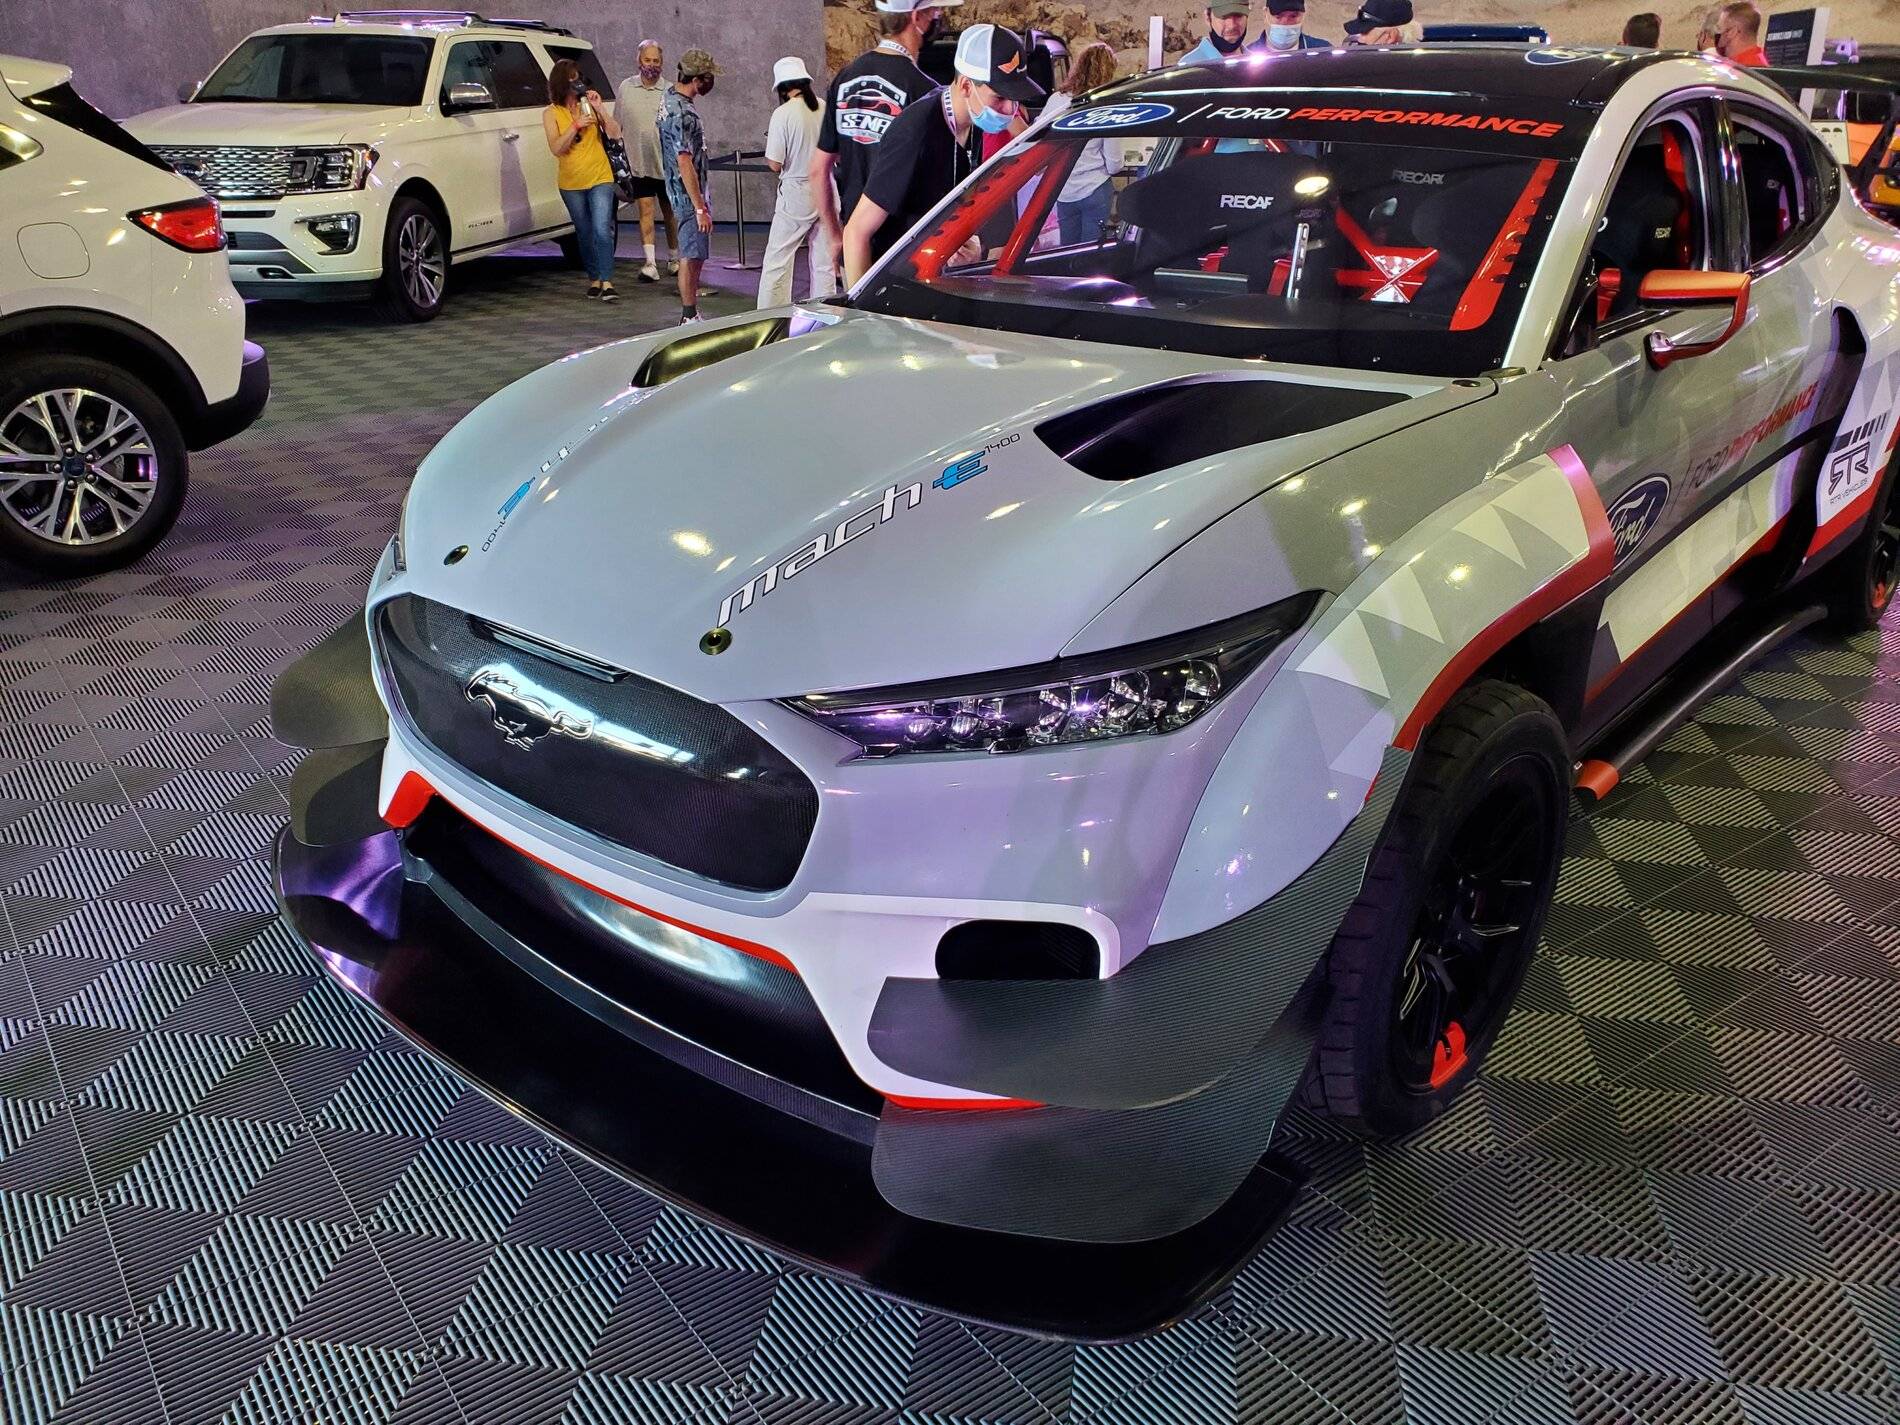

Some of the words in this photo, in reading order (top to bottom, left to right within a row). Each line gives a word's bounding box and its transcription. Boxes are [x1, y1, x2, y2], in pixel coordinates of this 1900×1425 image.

[1067, 105, 1152, 128] Ford
[1207, 107, 1291, 120] FORD
[1288, 108, 1565, 138] PERFORMANCE
[717, 482, 922, 628] mach
[932, 450, 988, 490] E
[984, 433, 1021, 453] 1400
